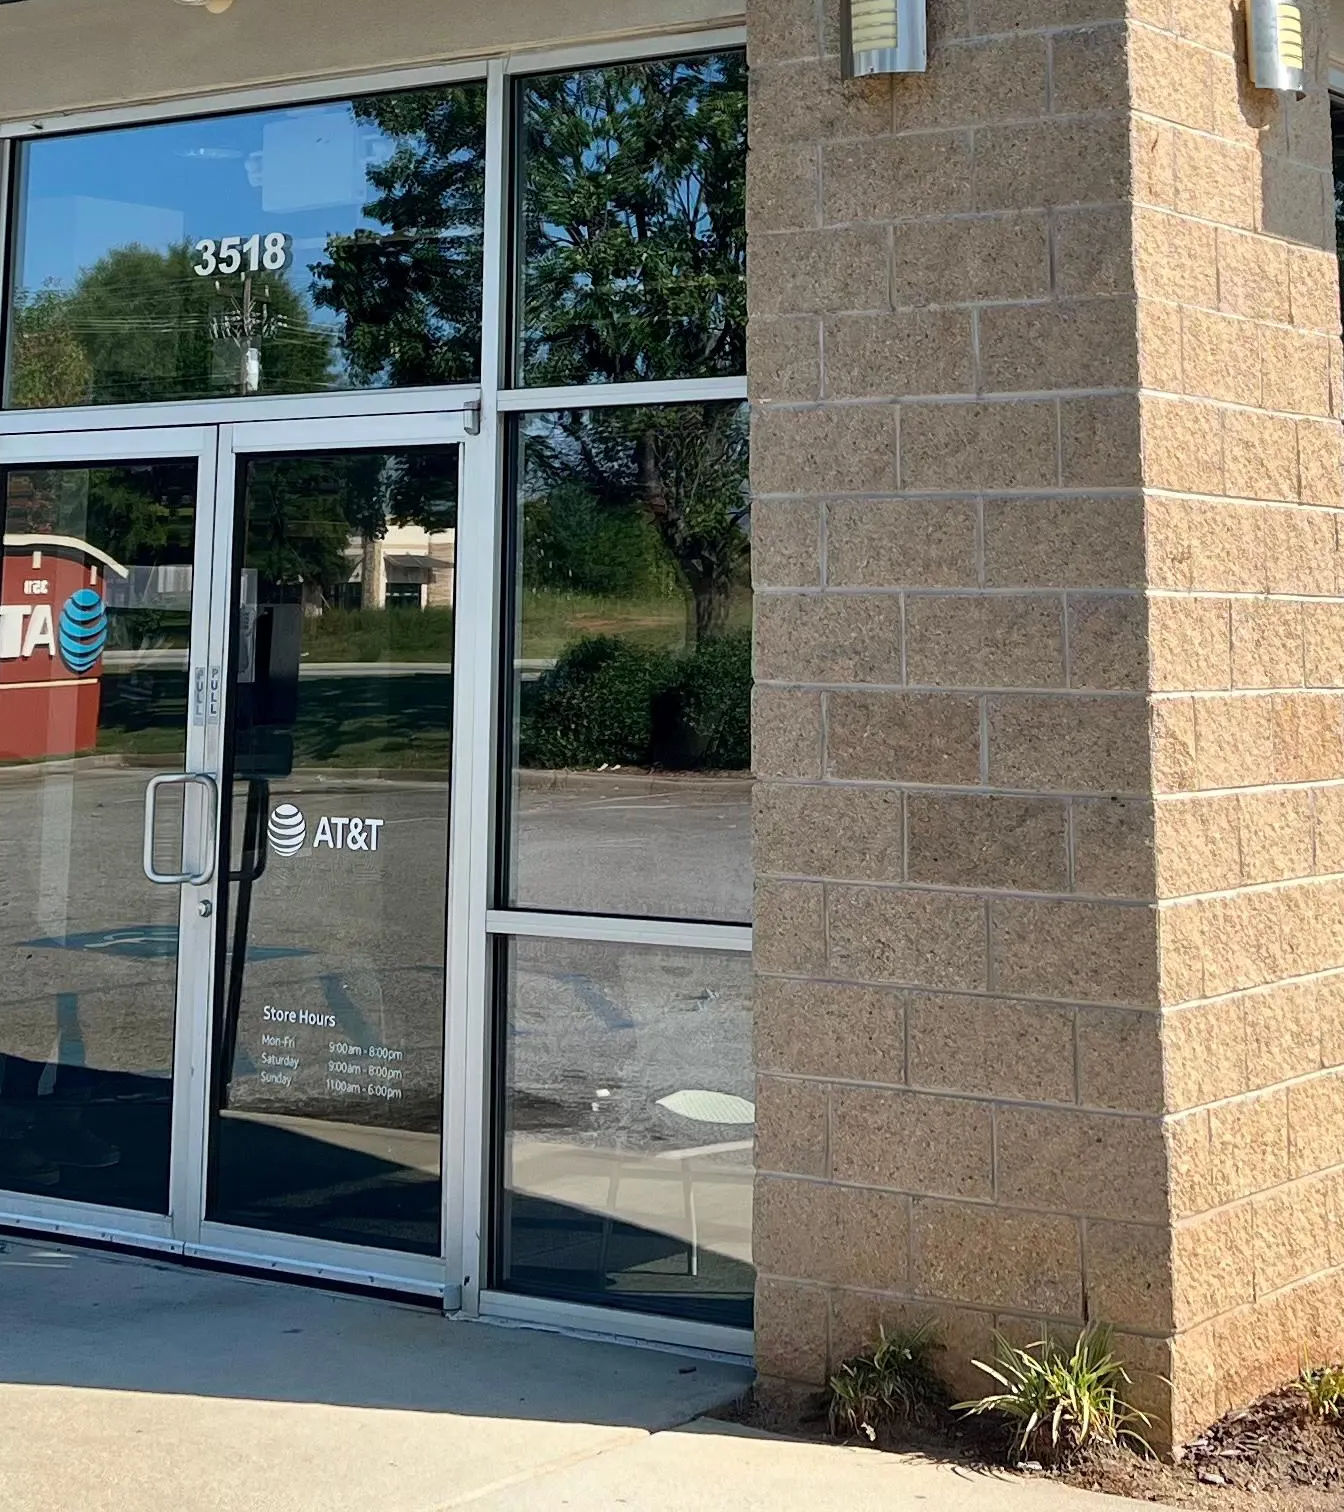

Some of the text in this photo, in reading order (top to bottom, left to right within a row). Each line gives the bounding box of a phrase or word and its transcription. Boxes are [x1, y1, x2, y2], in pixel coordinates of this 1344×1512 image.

[194, 232, 286, 277] 3518
[195, 669, 204, 716] PULL
[210, 668, 218, 715] PULL
[313, 816, 384, 851] AT&T
[263, 1005, 336, 1027] Store Hours
[261, 1051, 300, 1070] Saturday
[328, 1060, 361, 1076] 9:00am
[368, 1064, 403, 1080] 8:00pm
[329, 1041, 362, 1056] 9:00am
[368, 1045, 403, 1062] 8:00pm
[260, 1070, 293, 1088] Sunday
[367, 1083, 402, 1101] 6:00pm
